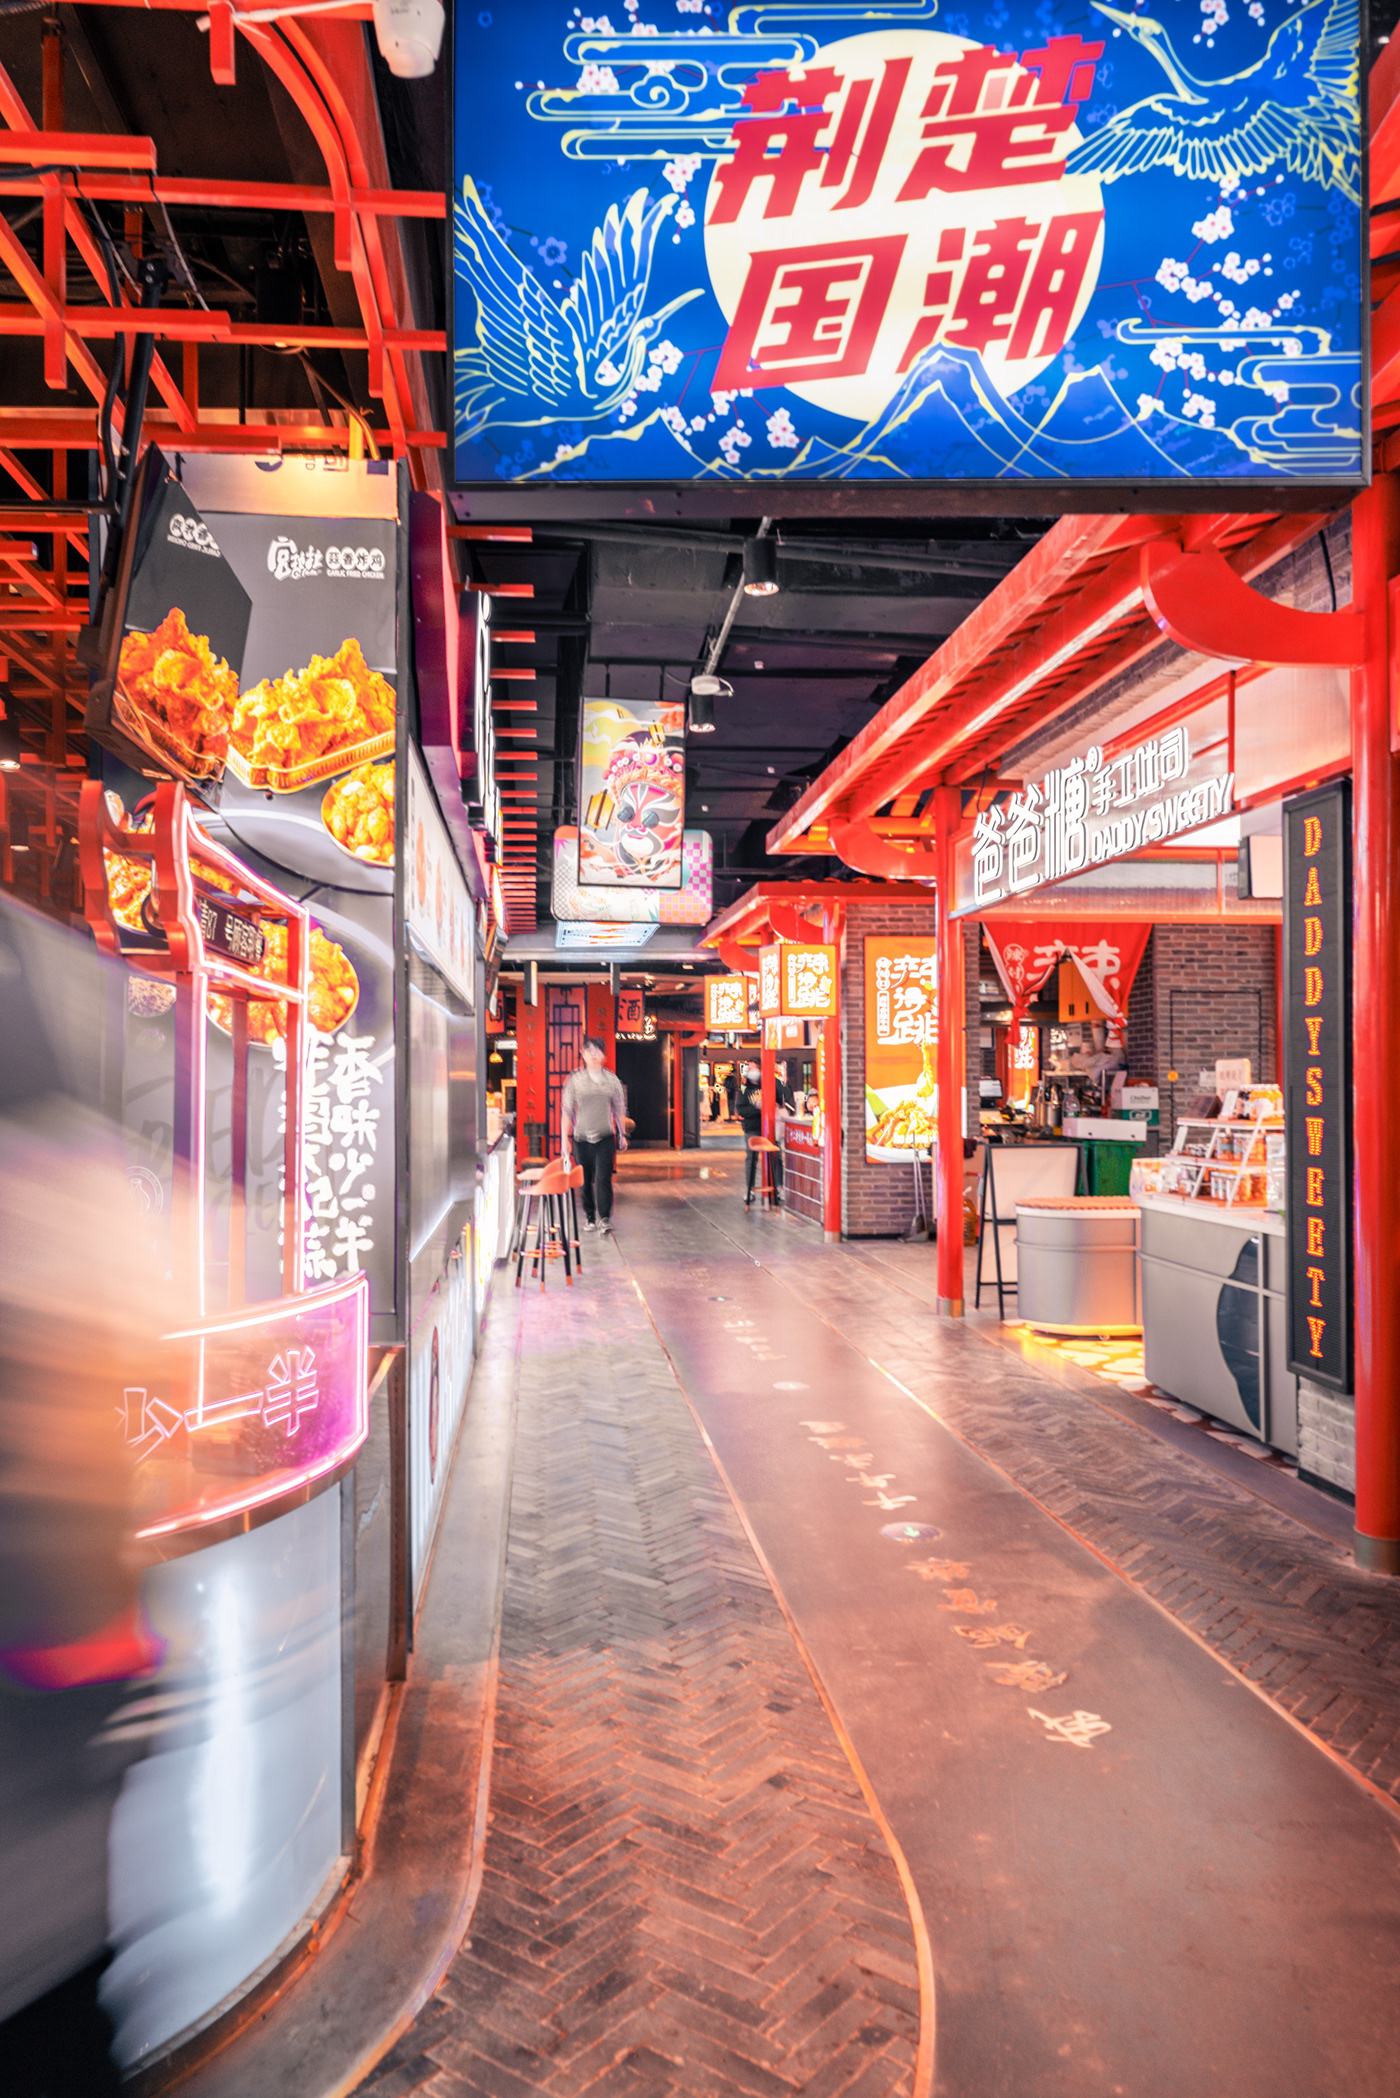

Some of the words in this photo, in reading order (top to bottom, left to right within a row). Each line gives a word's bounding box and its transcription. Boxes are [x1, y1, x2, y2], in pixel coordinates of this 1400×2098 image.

[706, 34, 1106, 226] 荆楚
[710, 208, 1105, 393] 国潮
[971, 757, 1090, 906] 爸爸糖
[1092, 727, 1188, 816] 手工吐司
[1091, 808, 1149, 864] DADDY
[1149, 772, 1235, 841] SWEETY
[618, 998, 642, 1021] 酒
[327, 1031, 384, 1273] 香味少一半
